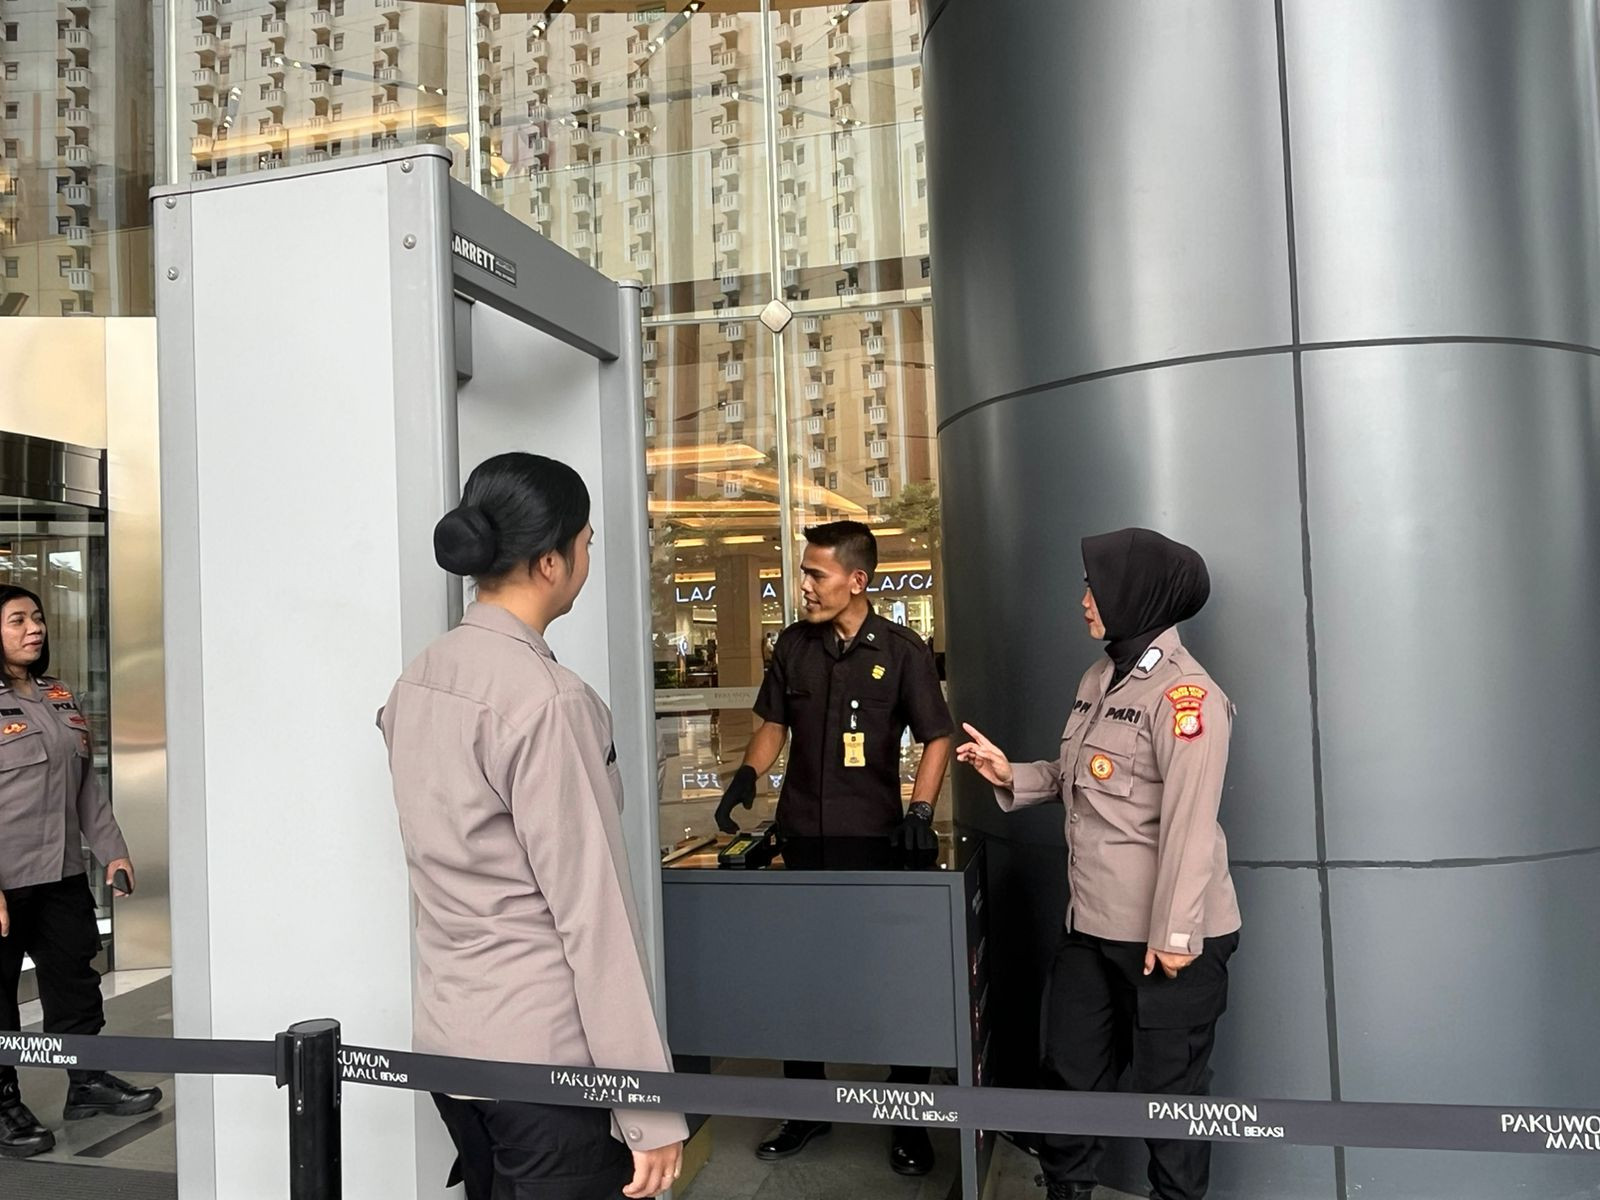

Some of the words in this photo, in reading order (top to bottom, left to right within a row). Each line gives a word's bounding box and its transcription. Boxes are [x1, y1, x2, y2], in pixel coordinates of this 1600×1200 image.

[452, 235, 495, 272] ARRETT
[0, 1036, 63, 1052] PAKUWON
[20, 1050, 52, 1064] MALL
[342, 1065, 378, 1080] MALL
[836, 1087, 934, 1106] PAKUWON
[872, 1104, 919, 1120] MALL
[1148, 1102, 1258, 1122] PAKUWON
[1188, 1120, 1241, 1137] MALL
[1243, 1126, 1285, 1137] BEKASI
